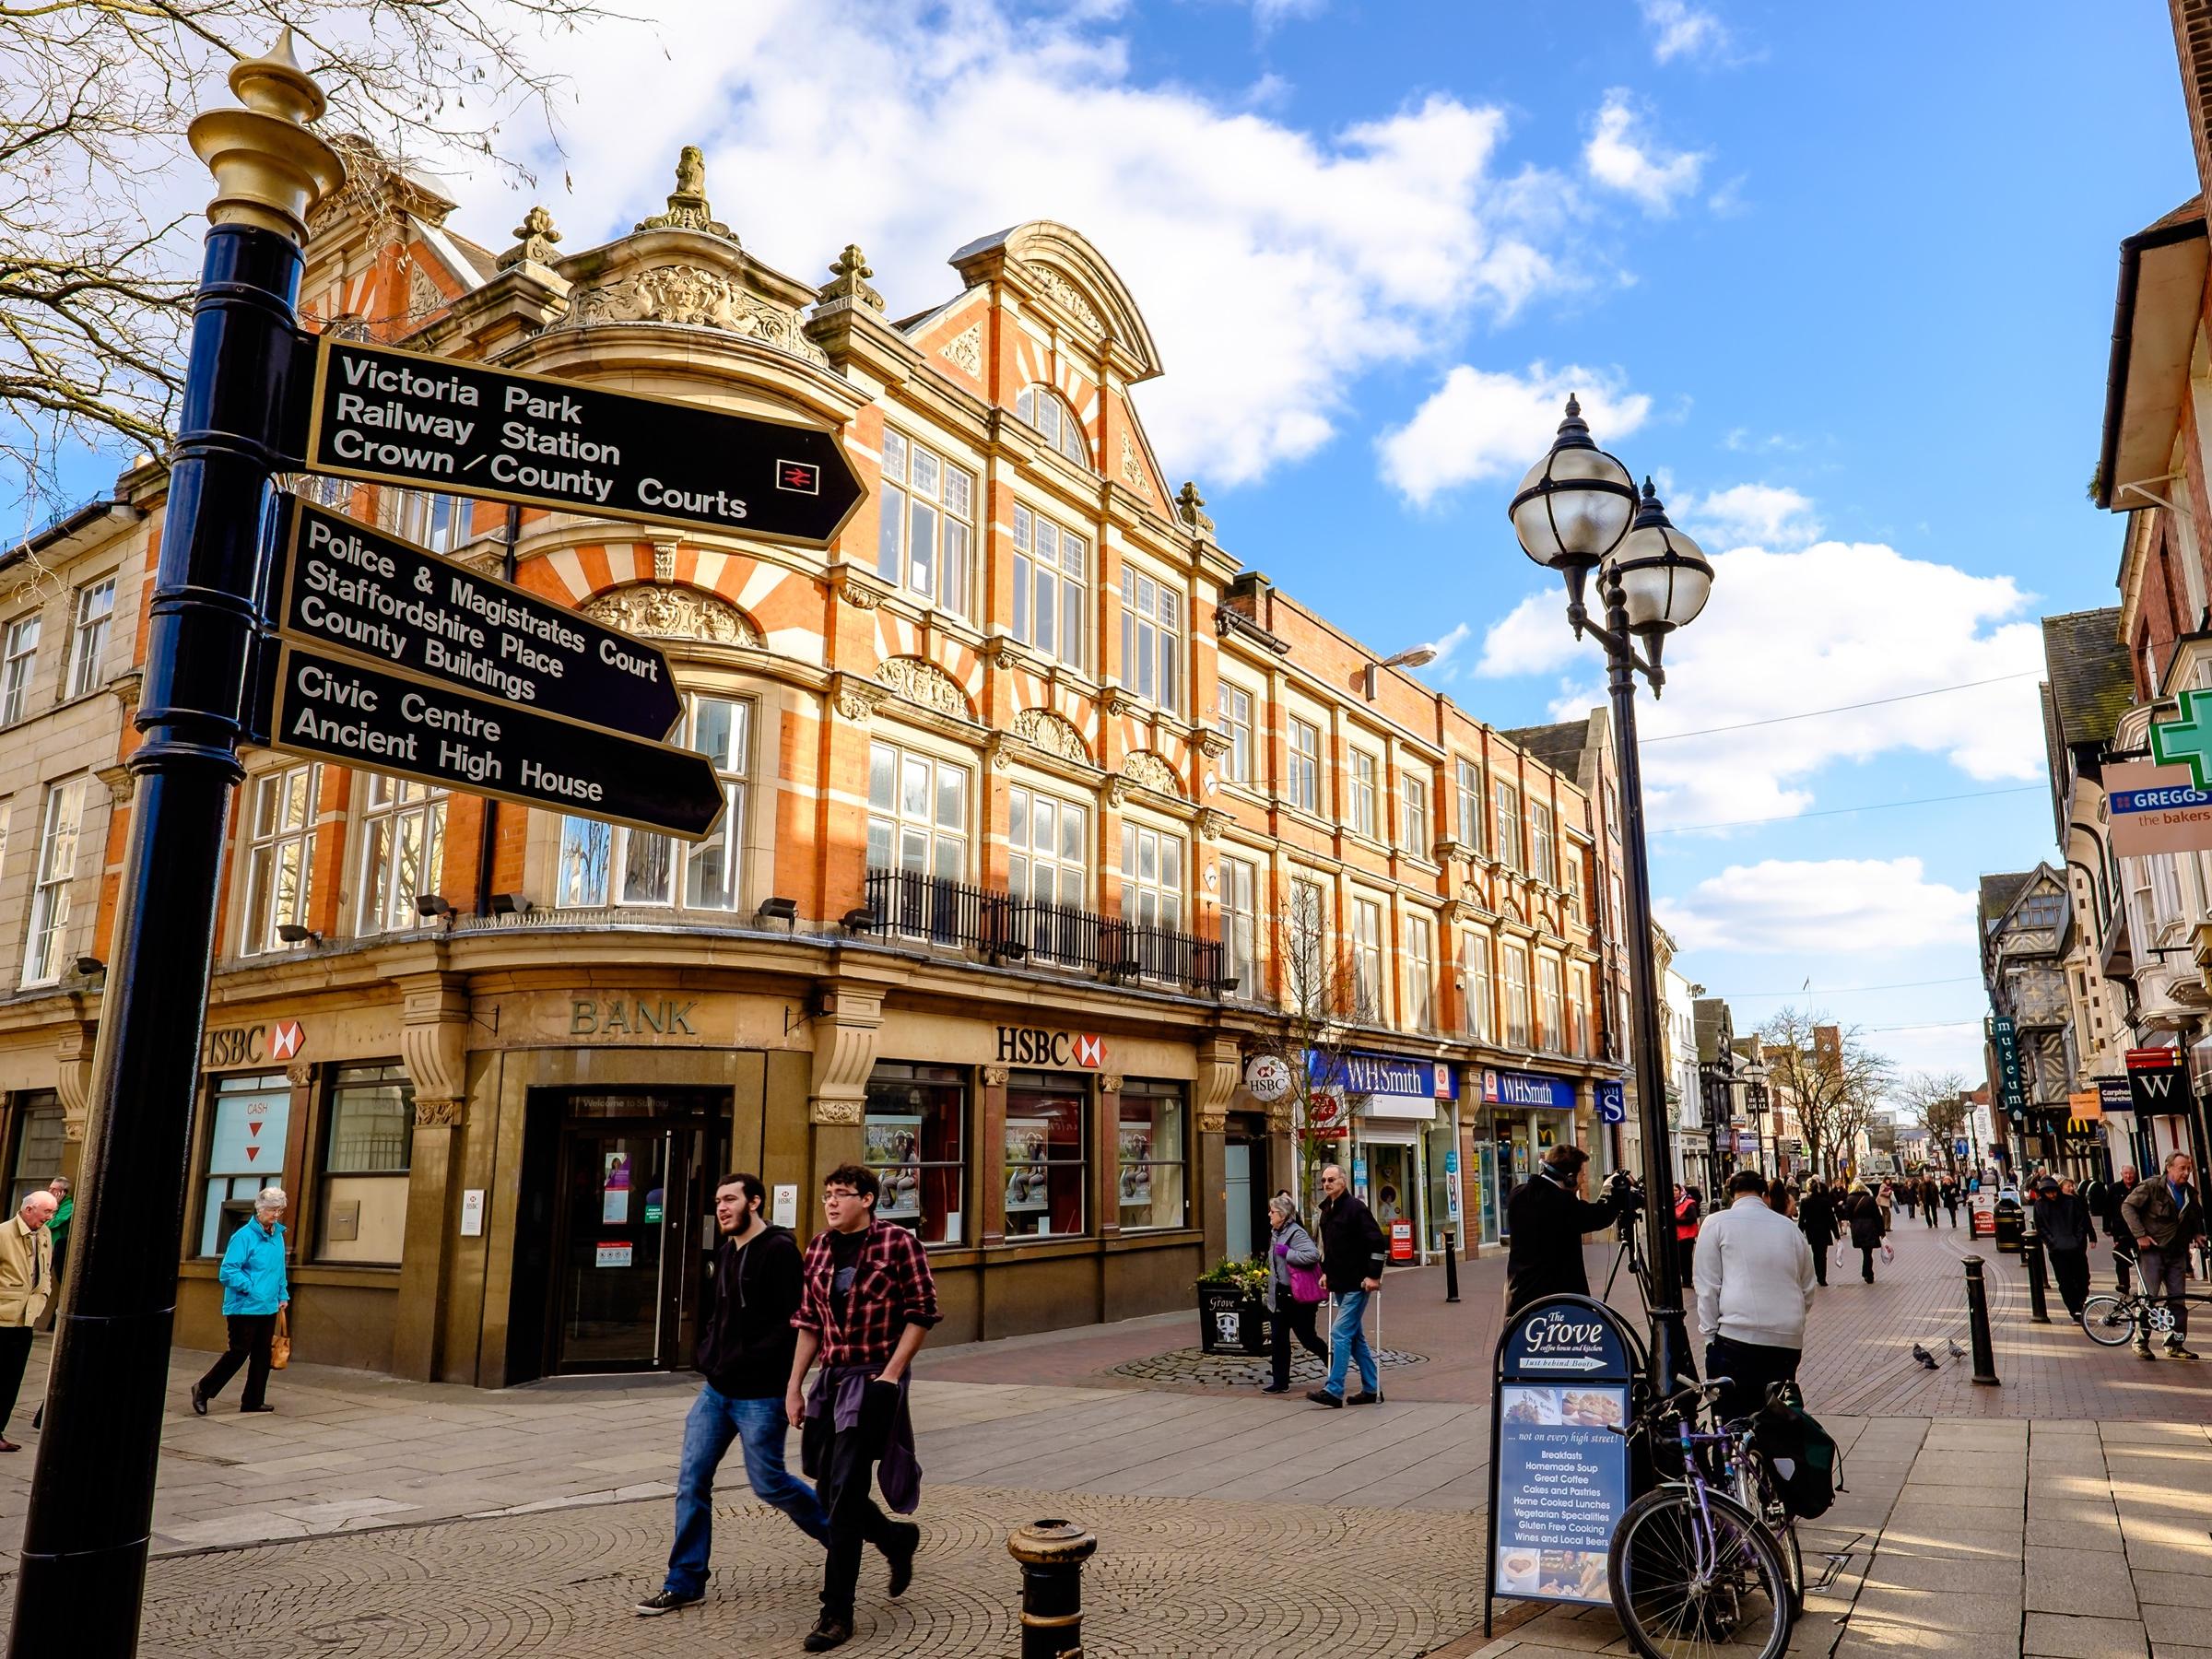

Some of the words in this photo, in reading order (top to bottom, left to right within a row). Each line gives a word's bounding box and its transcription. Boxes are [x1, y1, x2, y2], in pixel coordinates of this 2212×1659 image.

[342, 356, 479, 406] Victoria
[505, 385, 582, 424] Park
[337, 394, 475, 445] Railway
[501, 422, 619, 465] Station
[334, 429, 454, 474] Crown
[491, 454, 613, 502] County
[638, 478, 747, 519] Courts
[309, 520, 395, 578] Police
[414, 566, 433, 594] &
[450, 578, 585, 653] Magistrates
[599, 638, 658, 683] Court
[304, 559, 485, 648] Staffordshire
[501, 633, 564, 677] Place
[300, 596, 406, 659] County
[425, 641, 535, 701] Buildings
[298, 665, 378, 712] Civic
[401, 692, 501, 741] Centre
[293, 707, 417, 761] Ancient
[439, 739, 501, 782] High
[521, 760, 603, 802] House
[2134, 788, 2208, 807] GREGGS
[2138, 815, 2159, 827] the
[2162, 811, 2211, 824] bakers
[570, 1000, 698, 1034] BANK
[995, 1026, 1070, 1066] HSBC
[1997, 1021, 2022, 1104] museum
[1347, 1057, 1422, 1094] WHSmith
[1250, 1078, 1286, 1092] HSBC
[1502, 1077, 1553, 1105] WHSmith
[1603, 1087, 1619, 1096] WH
[2137, 1074, 2175, 1099] W
[247, 1102, 268, 1115] CASH
[583, 1099, 625, 1107] Welcome
[1604, 1094, 1622, 1122] S
[1208, 1297, 1235, 1312] Grove
[1547, 1311, 1565, 1322] The
[1525, 1317, 1603, 1353] Grove
[1539, 1344, 1556, 1353] coffee
[1571, 1344, 1583, 1352] and
[1583, 1344, 1603, 1353] kitchen
[1571, 1359, 1594, 1368] Boots
[1518, 1432, 1532, 1441] not
[1547, 1434, 1569, 1444] every
[1570, 1432, 1589, 1445] high
[1589, 1433, 1618, 1443] street!
[1541, 1450, 1583, 1460] Breakfasts
[1525, 1462, 1575, 1472] Homemade
[1577, 1464, 1598, 1474] Soup
[1534, 1474, 1559, 1483] Great
[1559, 1475, 1590, 1484] Coffee
[1523, 1485, 1548, 1494] Cakes
[1550, 1486, 1568, 1495] and
[1570, 1488, 1601, 1497] Pastries
[1513, 1496, 1538, 1506] Home
[1540, 1498, 1573, 1508] Cooked
[1575, 1500, 1611, 1510] Lunches
[1513, 1508, 1559, 1519] Vegetarian
[1561, 1511, 1610, 1522] Specialities
[1518, 1521, 1547, 1530] Gluten
[1548, 1522, 1567, 1531] Free
[1569, 1524, 1606, 1535] Cooking
[1514, 1532, 1539, 1542] Wines
[1540, 1534, 1559, 1543] and
[1560, 1535, 1583, 1545] Local
[1585, 1536, 1609, 1547] Beers
